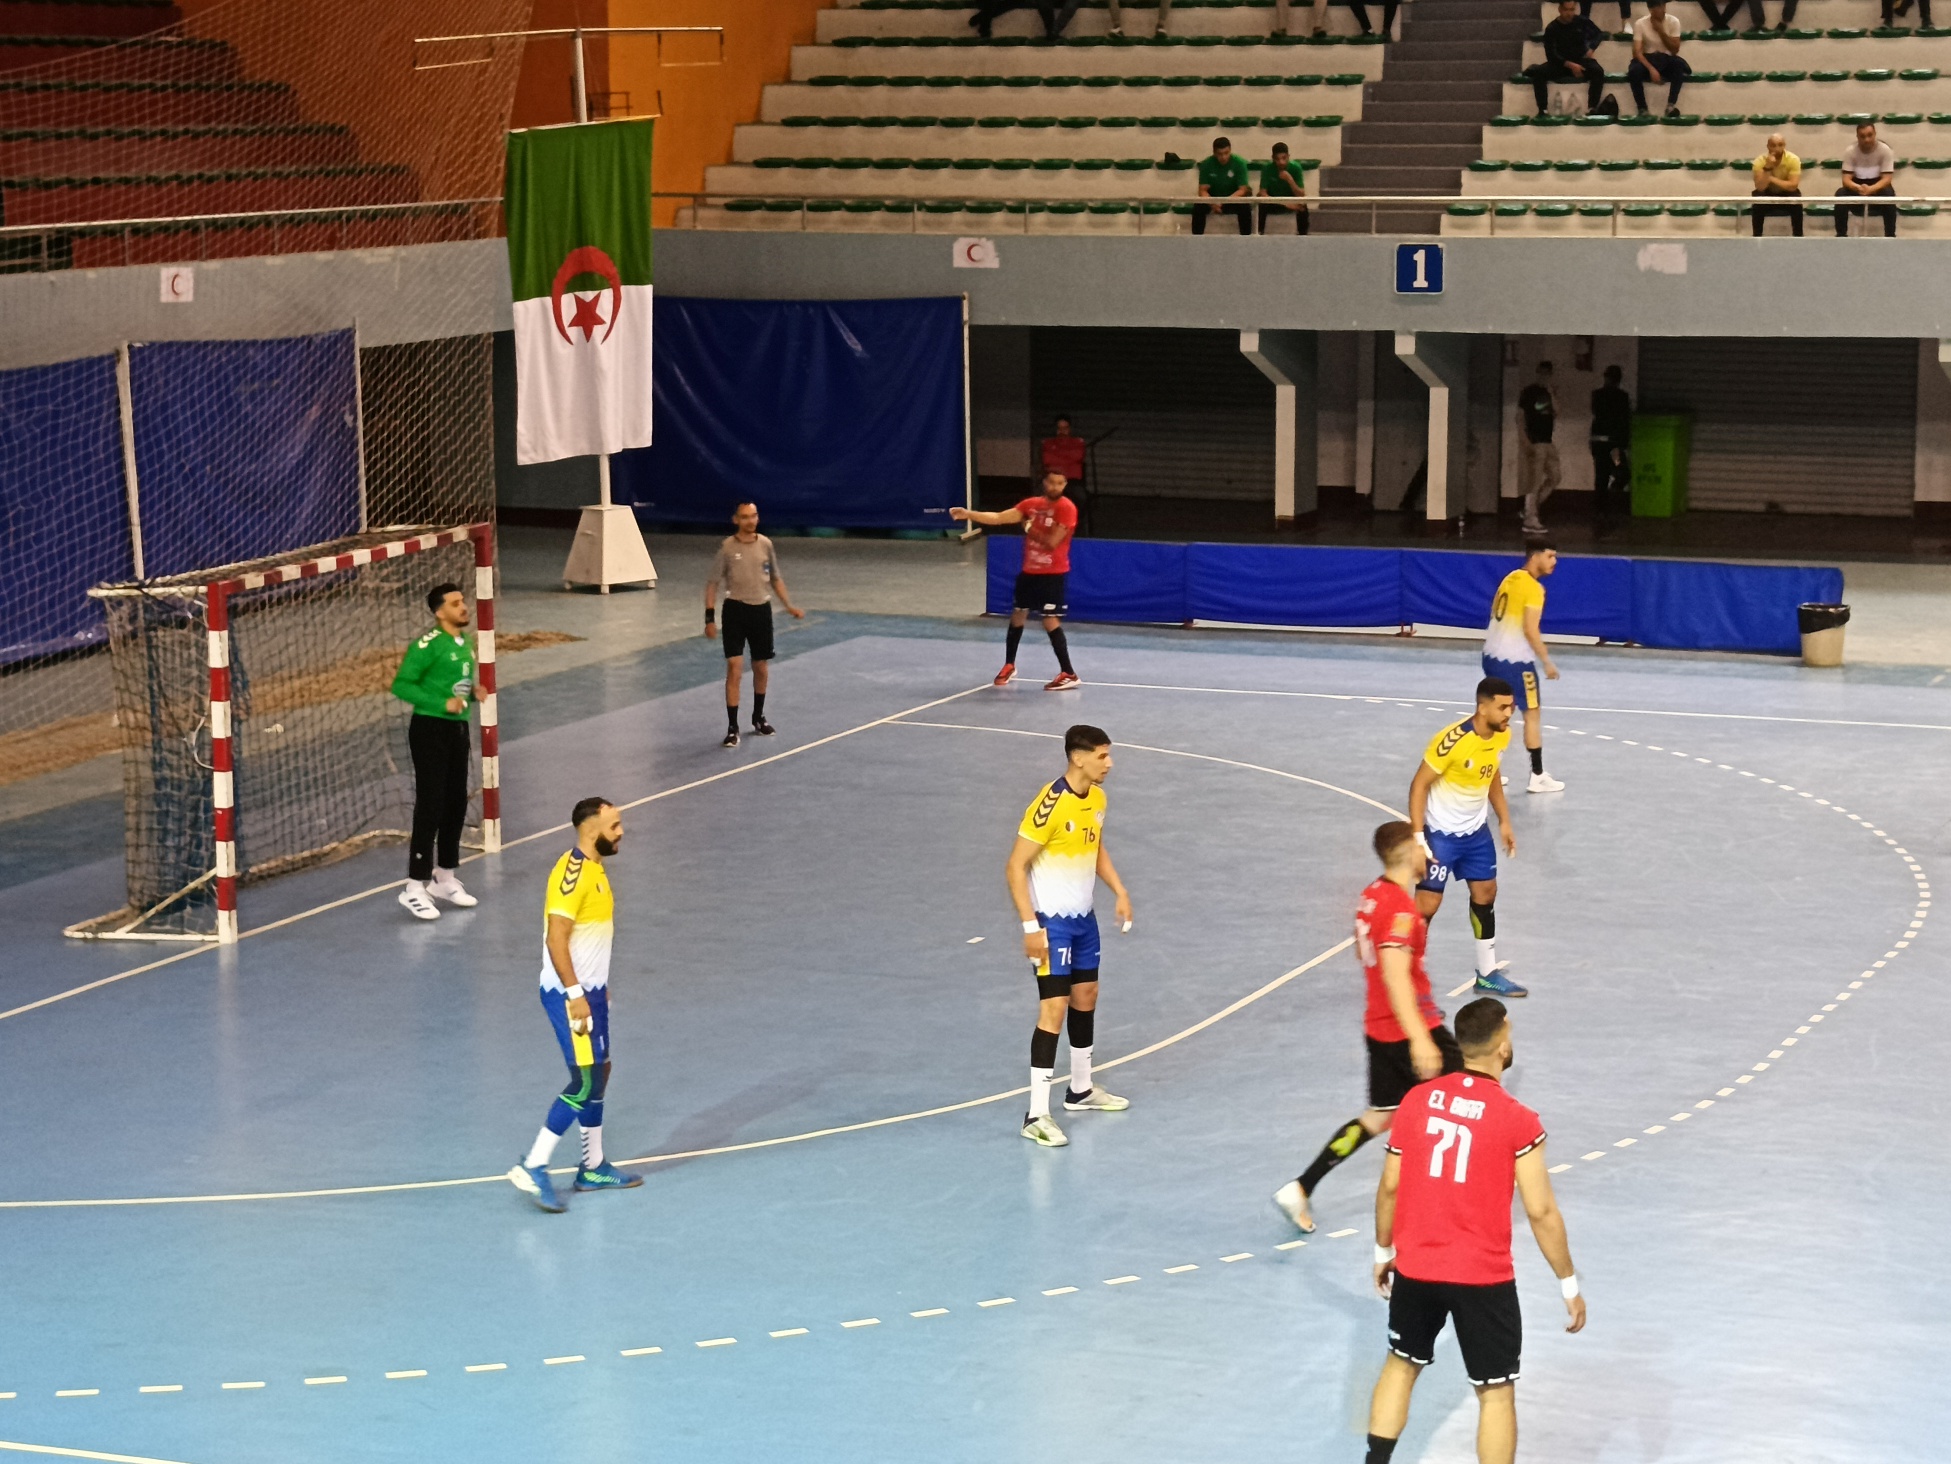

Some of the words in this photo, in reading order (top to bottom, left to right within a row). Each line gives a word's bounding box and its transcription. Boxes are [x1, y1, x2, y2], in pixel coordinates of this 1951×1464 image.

[1413, 249, 1429, 288] 1
[1479, 763, 1494, 780] 98
[1082, 826, 1096, 845] 76
[1429, 864, 1447, 882] 98
[1426, 1116, 1473, 1184] 71
